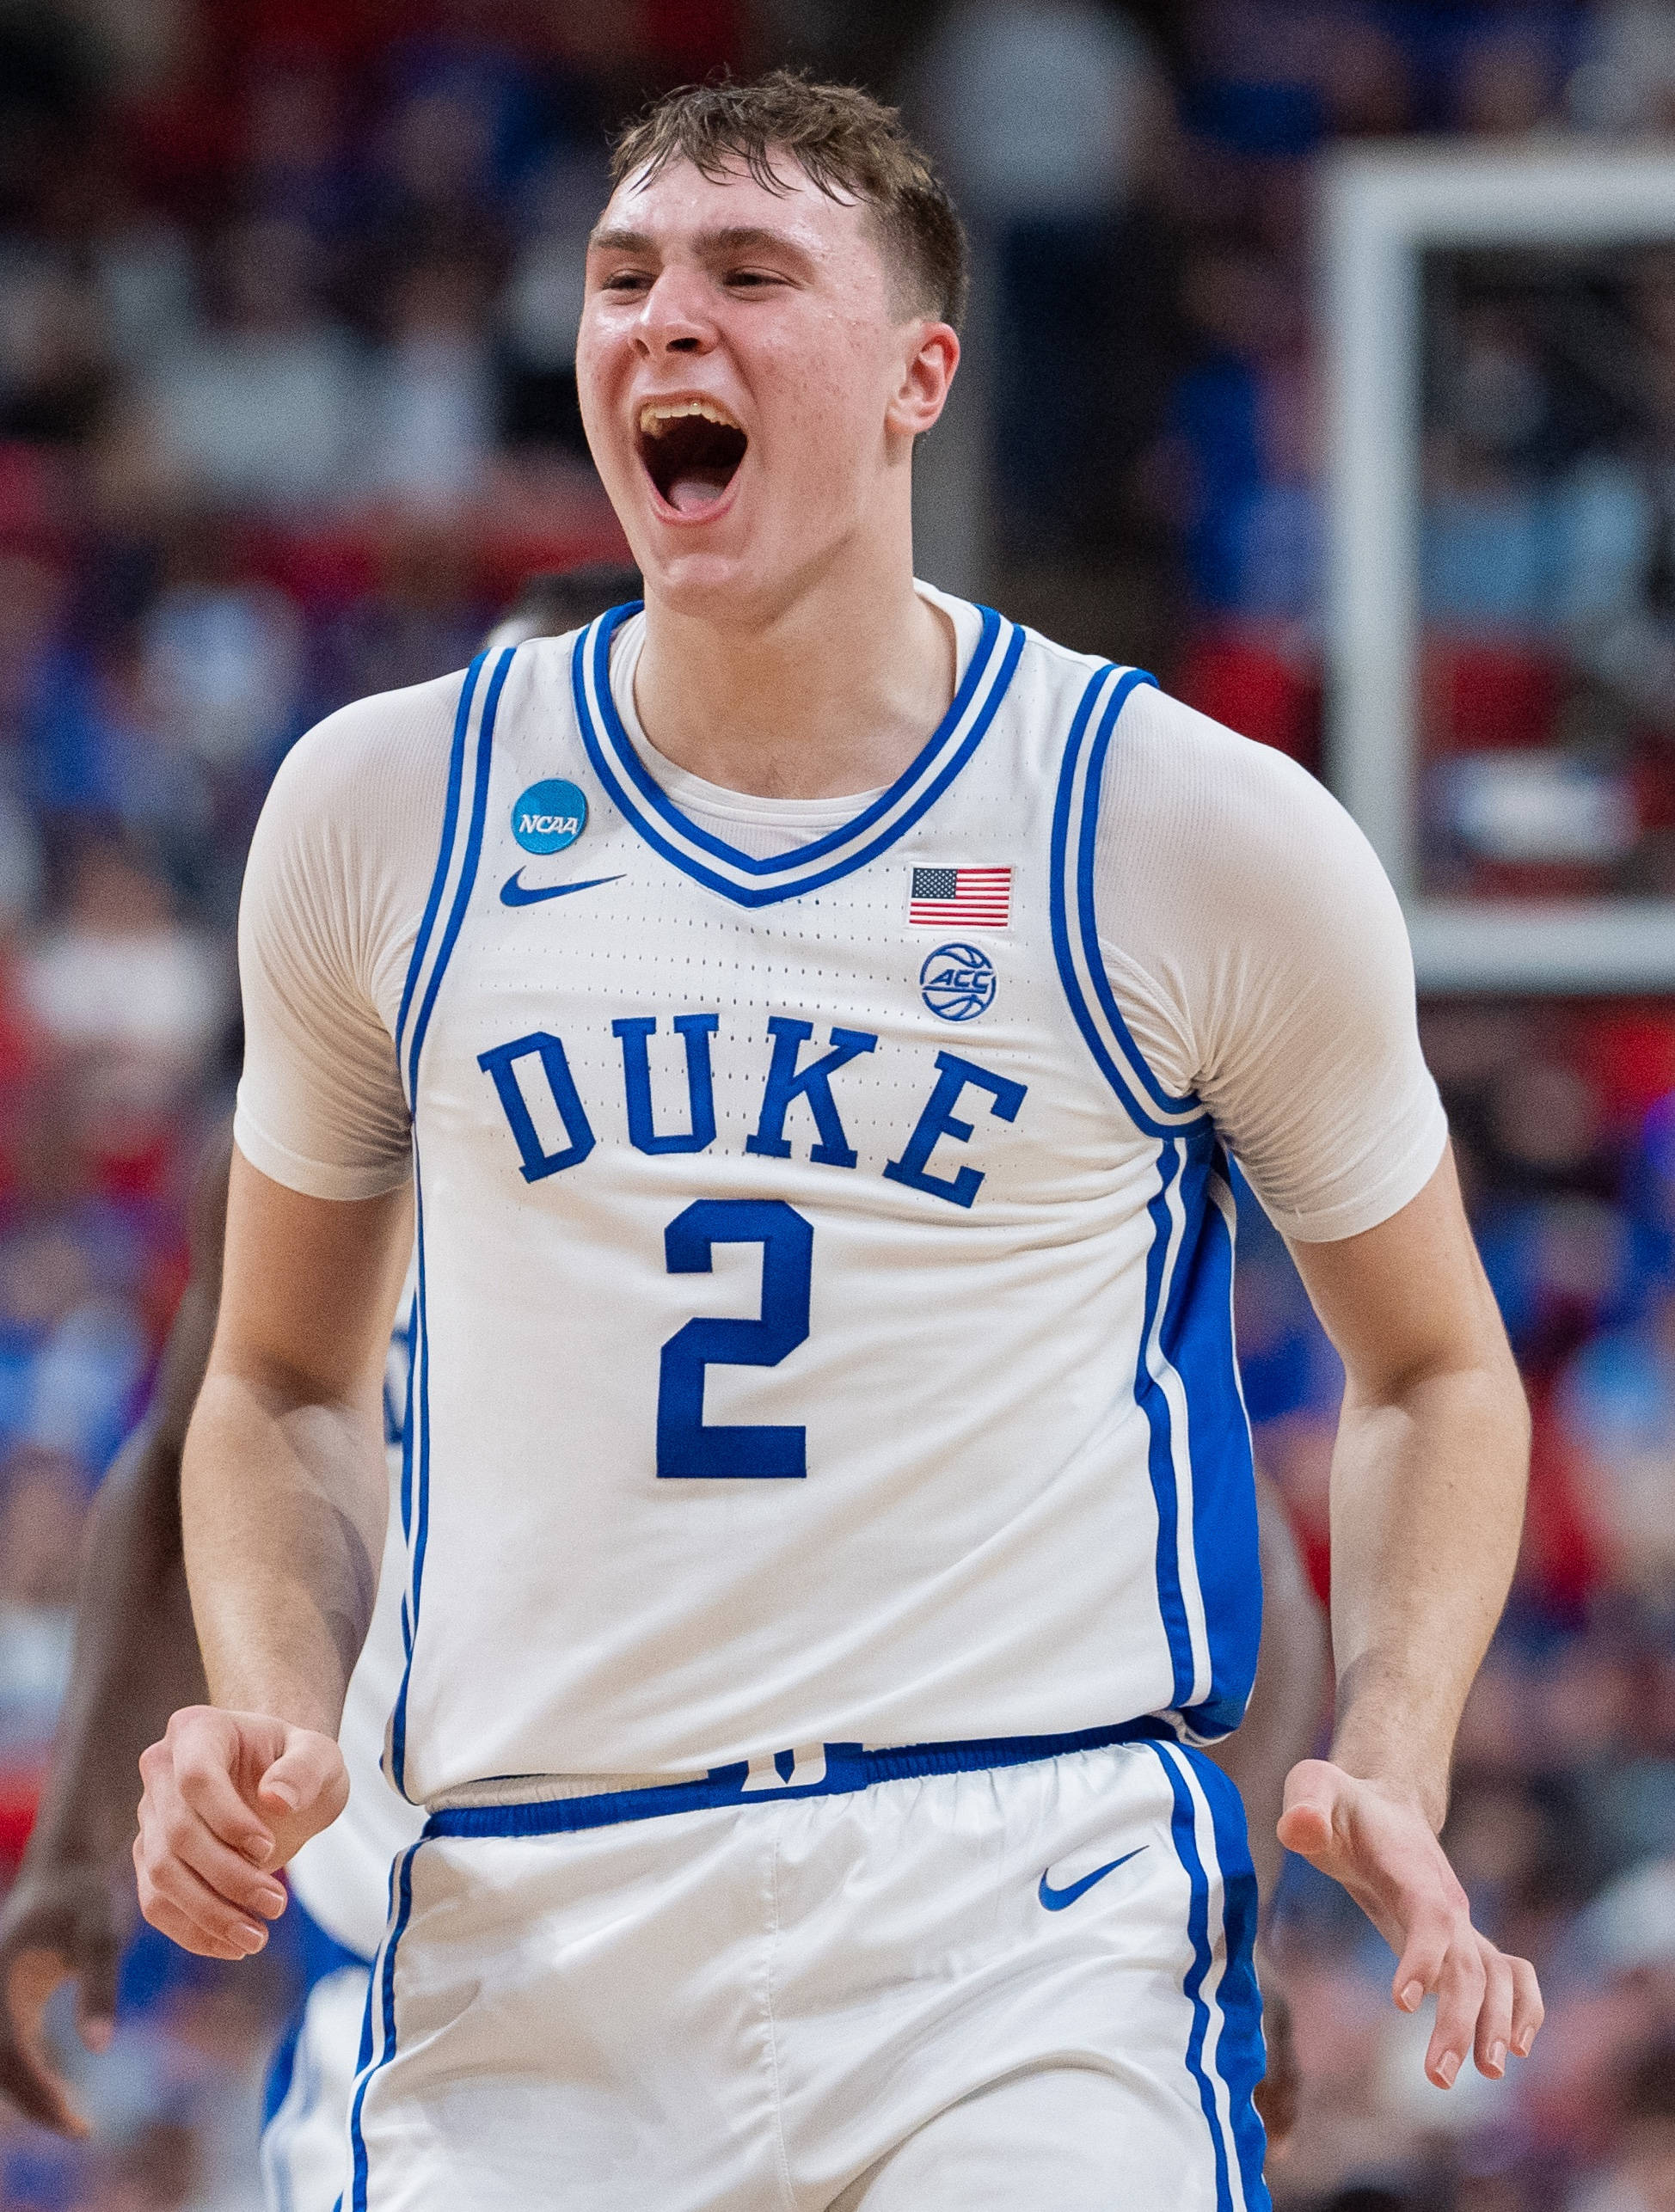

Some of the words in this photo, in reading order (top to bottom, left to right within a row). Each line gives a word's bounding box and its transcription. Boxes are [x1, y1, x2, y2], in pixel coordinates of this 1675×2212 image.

[518, 813, 579, 835] NCAA
[927, 968, 993, 990] ACC
[477, 1013, 1028, 1209] DUKE
[656, 1198, 814, 1479] 2
